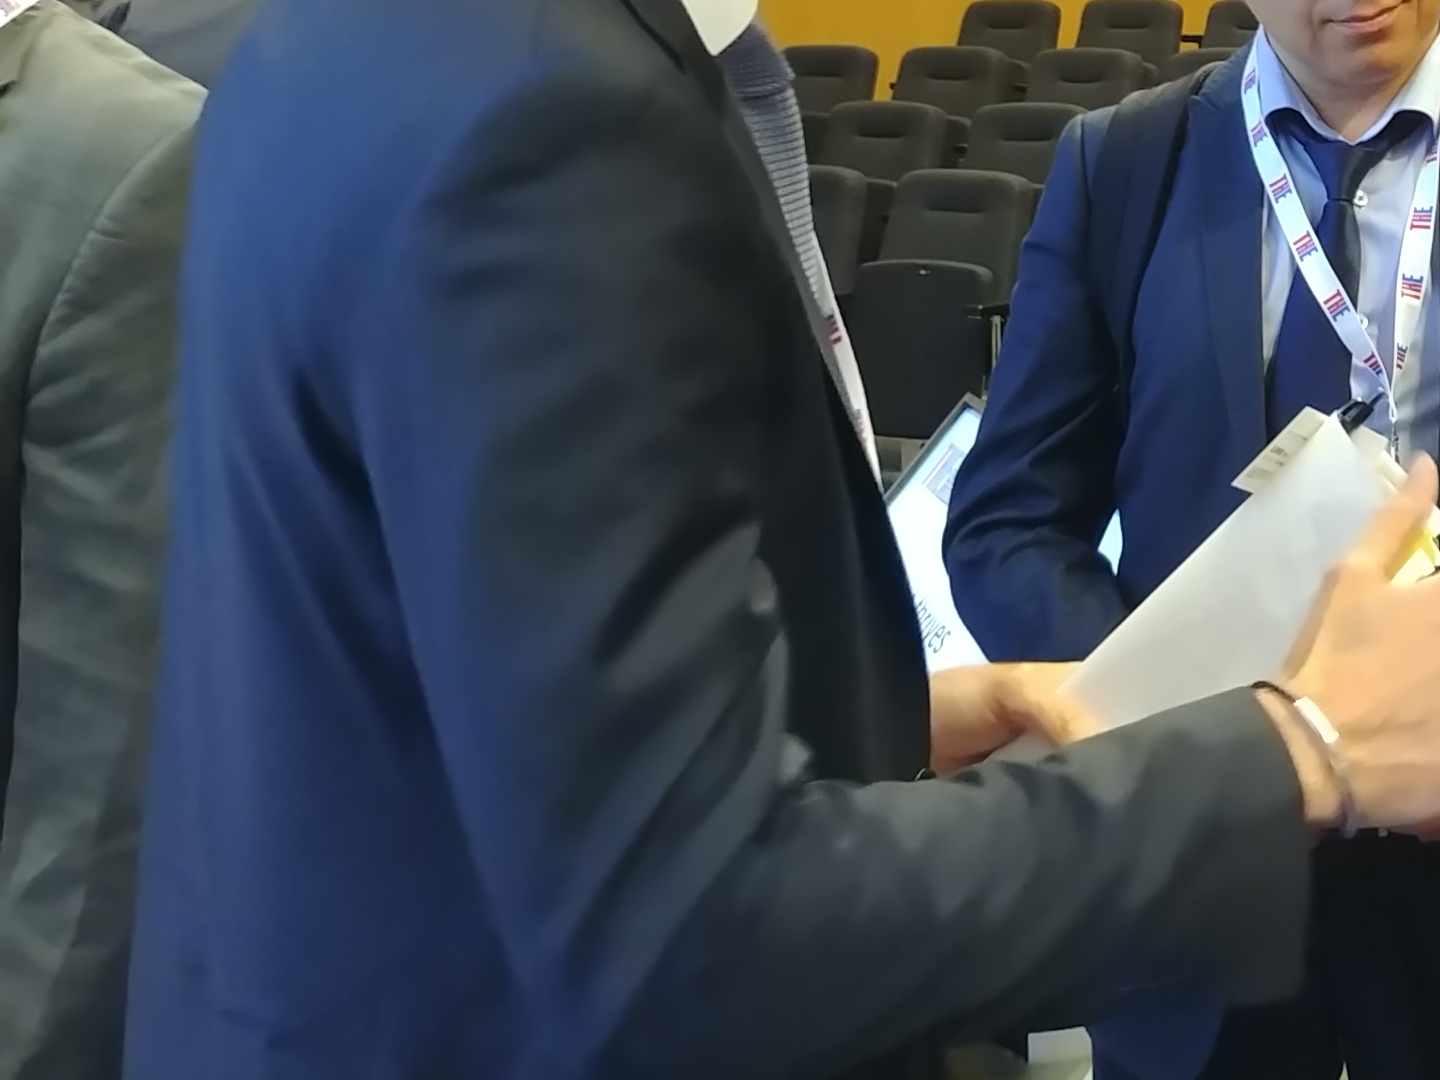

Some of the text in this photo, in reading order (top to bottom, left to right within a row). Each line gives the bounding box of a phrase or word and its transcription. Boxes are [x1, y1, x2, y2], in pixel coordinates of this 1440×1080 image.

[1269, 173, 1292, 204] THE
[1410, 206, 1433, 231] THE
[1293, 230, 1318, 262] THE
[1401, 273, 1423, 300] THE
[1323, 289, 1351, 322] THE
[1397, 342, 1408, 370] THE
